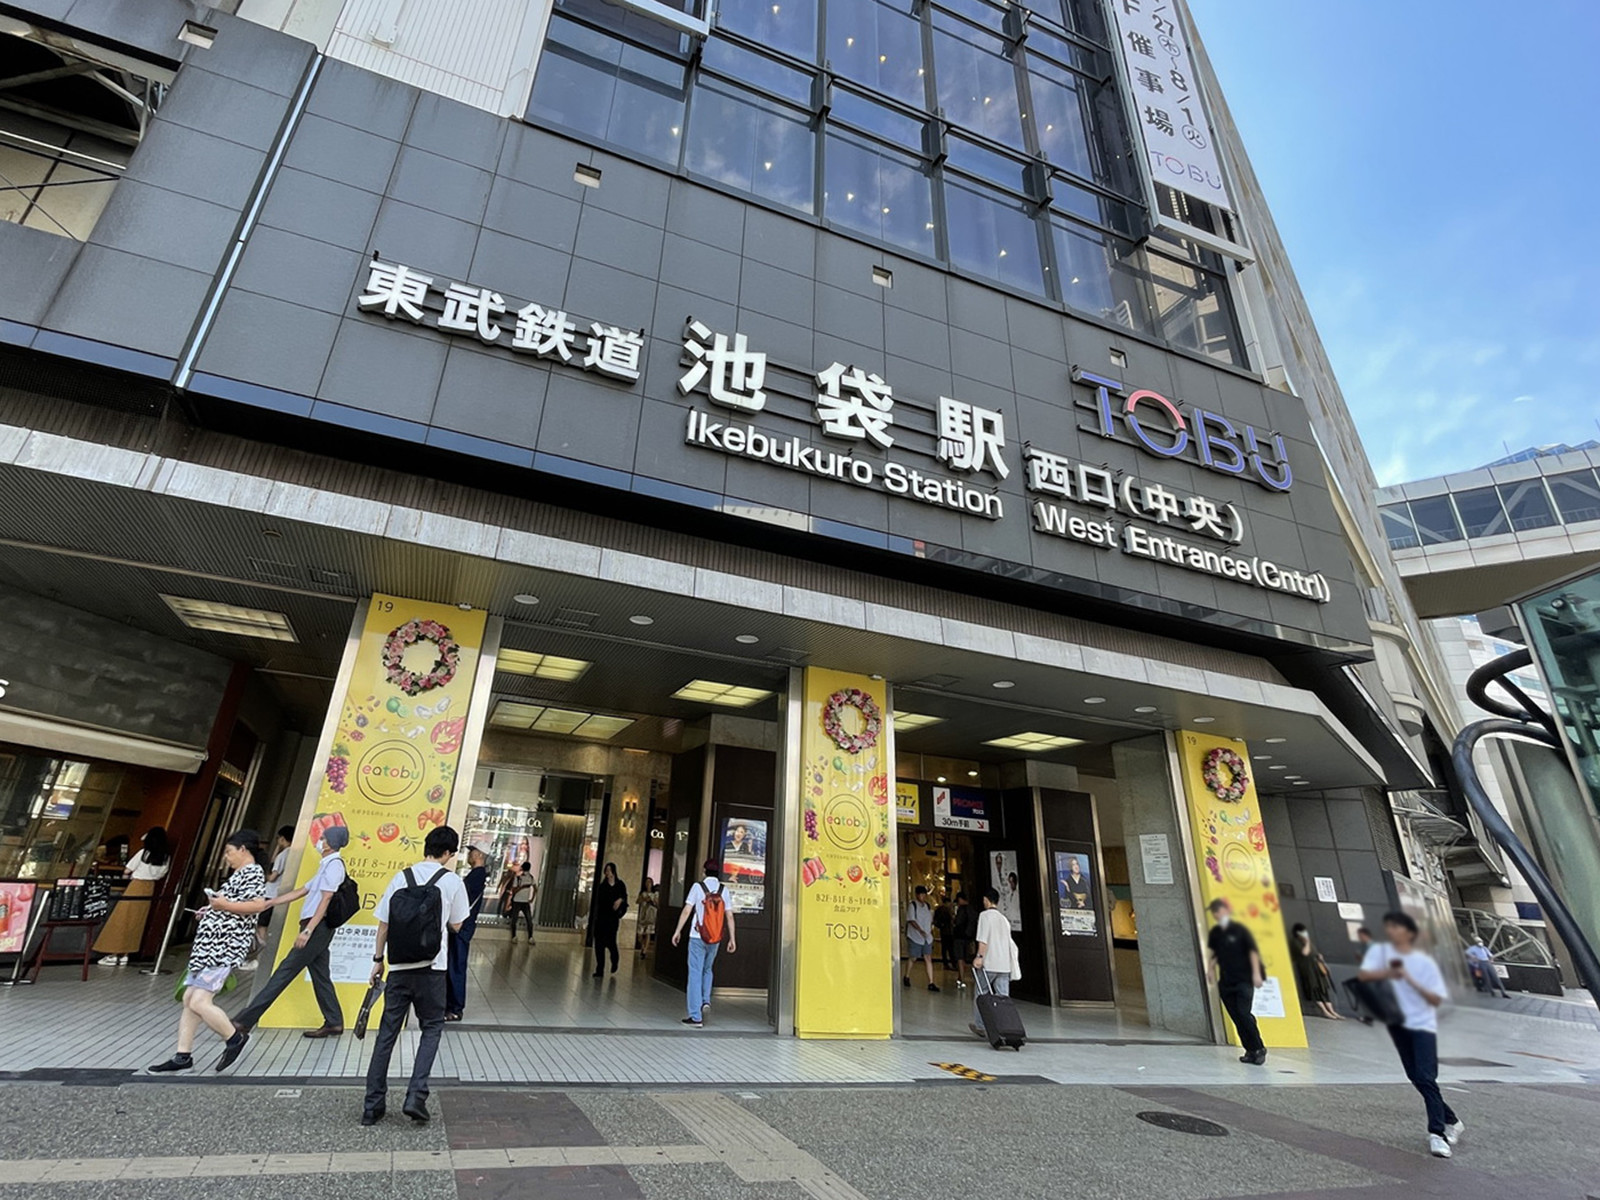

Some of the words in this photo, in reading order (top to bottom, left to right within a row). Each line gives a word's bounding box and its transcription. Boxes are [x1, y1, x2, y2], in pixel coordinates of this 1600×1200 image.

[1150, 150, 1222, 190] TOBU
[358, 260, 644, 384] 東武鉄道
[677, 319, 1010, 480] 池袋駅
[1026, 447, 1244, 546] 西口(中央)
[1072, 369, 1293, 491] TOBU
[684, 409, 873, 486] Ikebukuro
[883, 461, 1004, 519] Station
[1035, 501, 1119, 548] West
[377, 600, 394, 613] 19
[362, 764, 420, 780] eatobu
[825, 923, 870, 941] TOBU
